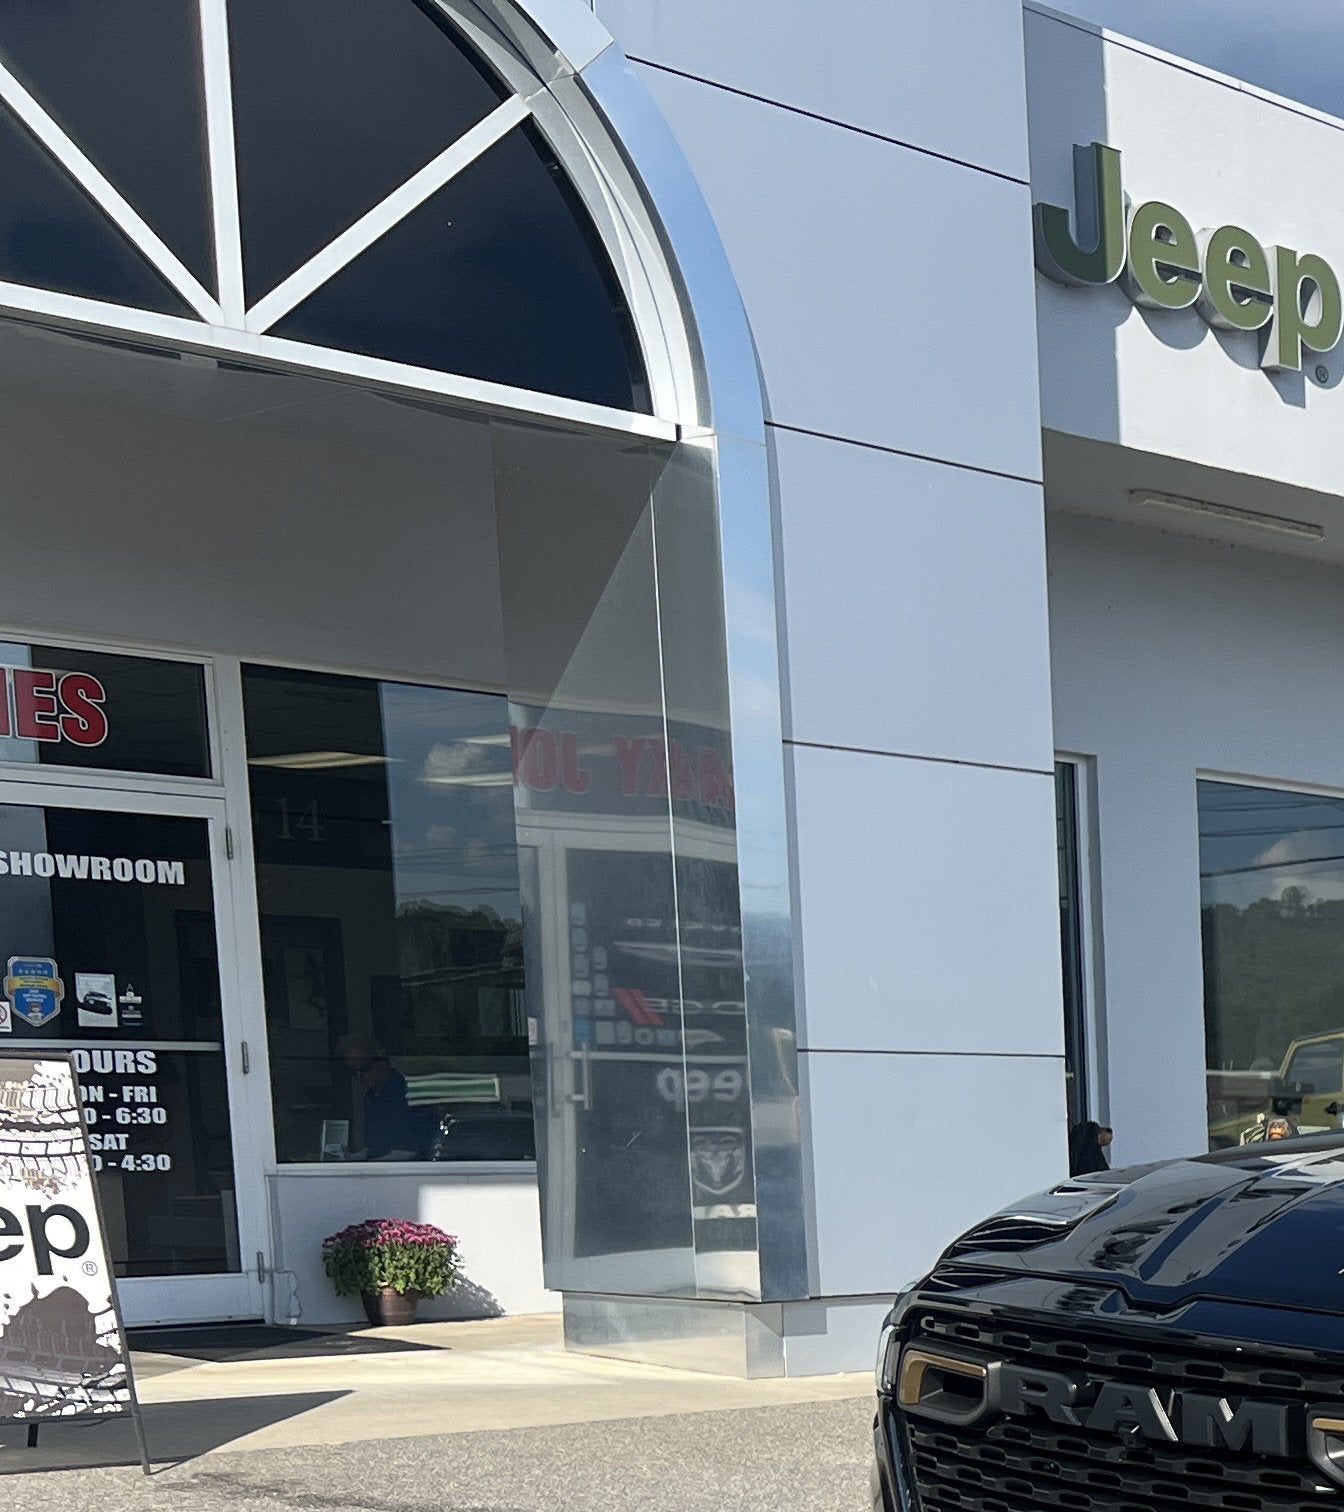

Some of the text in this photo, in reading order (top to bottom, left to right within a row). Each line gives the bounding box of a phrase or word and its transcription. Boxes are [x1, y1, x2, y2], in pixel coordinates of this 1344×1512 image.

[1032, 142, 1344, 372] Jeep
[0, 664, 108, 747] ES
[71, 1049, 158, 1074] OURS
[122, 1086, 157, 1102] FRI
[115, 1107, 166, 1124] 6:30
[88, 1133, 130, 1151] SAT
[121, 1154, 171, 1171] 4:30
[1003, 1360, 1291, 1457] RAM
